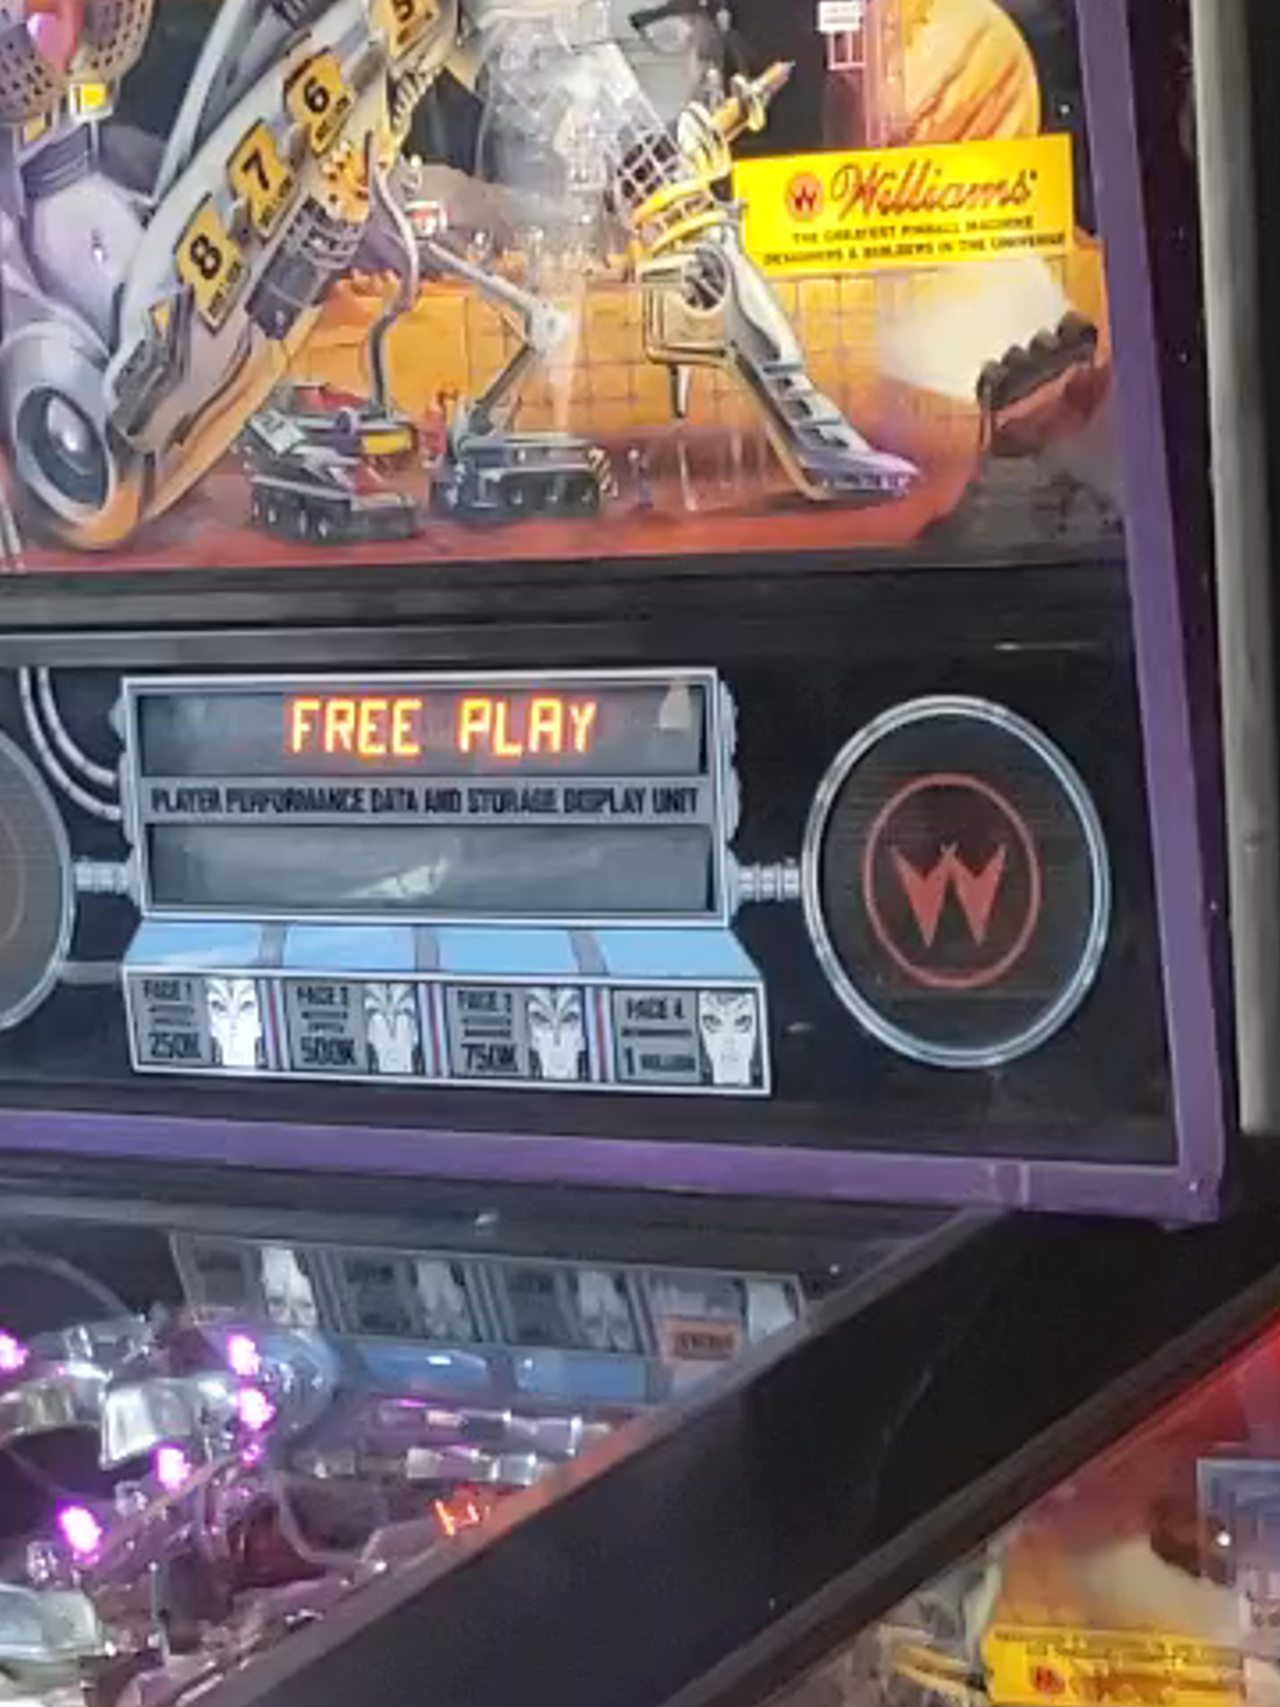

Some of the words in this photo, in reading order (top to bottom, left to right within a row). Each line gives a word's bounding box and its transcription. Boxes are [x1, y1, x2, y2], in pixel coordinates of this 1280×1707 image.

[303, 79, 332, 115] 6
[241, 147, 273, 191] 7
[189, 235, 223, 281] 8
[290, 698, 422, 756] FREE
[459, 698, 597, 756] PLAY
[651, 787, 699, 814] UNIT
[150, 1033, 201, 1061] 250K
[300, 1037, 356, 1066] 500K
[461, 1044, 518, 1072] 750K
